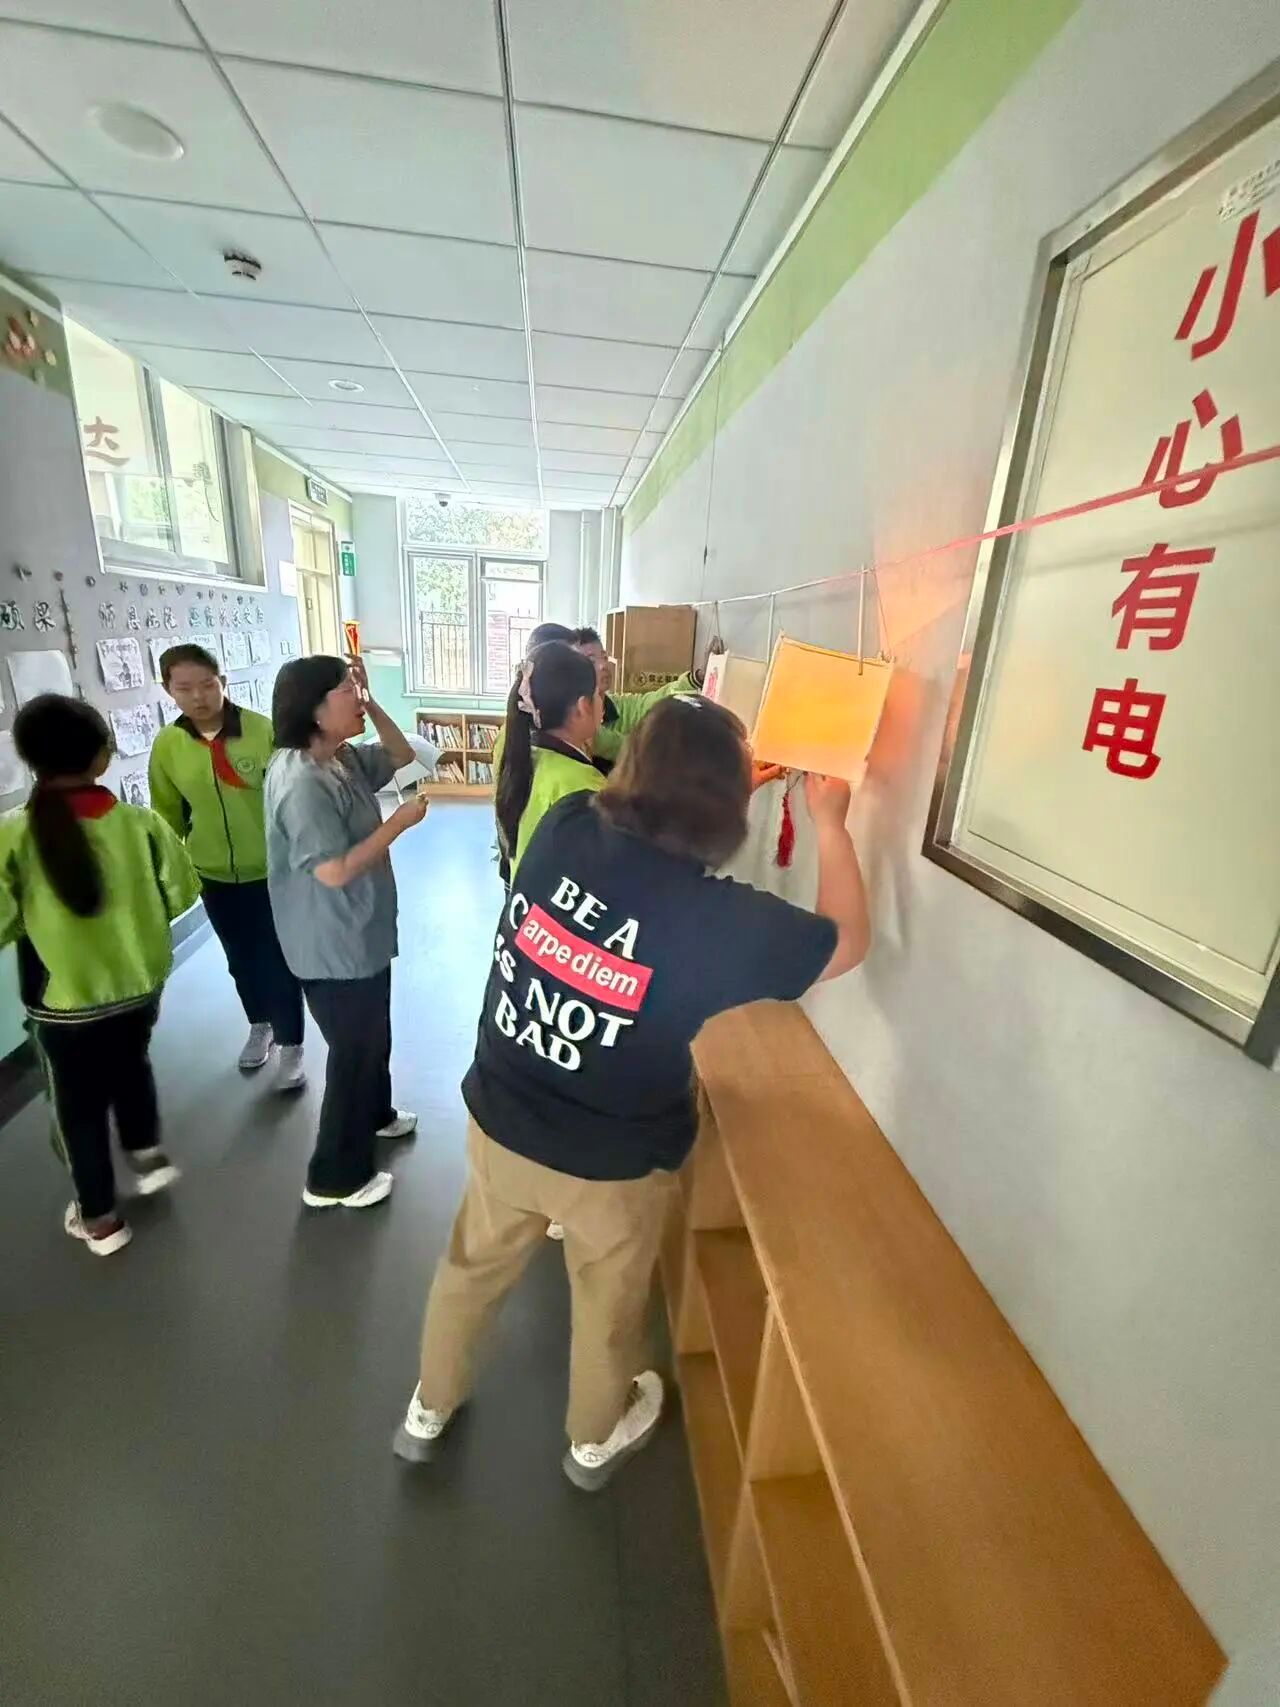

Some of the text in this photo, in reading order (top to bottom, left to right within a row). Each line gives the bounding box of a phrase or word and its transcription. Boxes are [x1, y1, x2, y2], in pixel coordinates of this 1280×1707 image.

[1083, 211, 1280, 779] 小心有电
[550, 877, 640, 959] BE A
[495, 991, 582, 1071] BAD
[526, 978, 633, 1048] NOT
